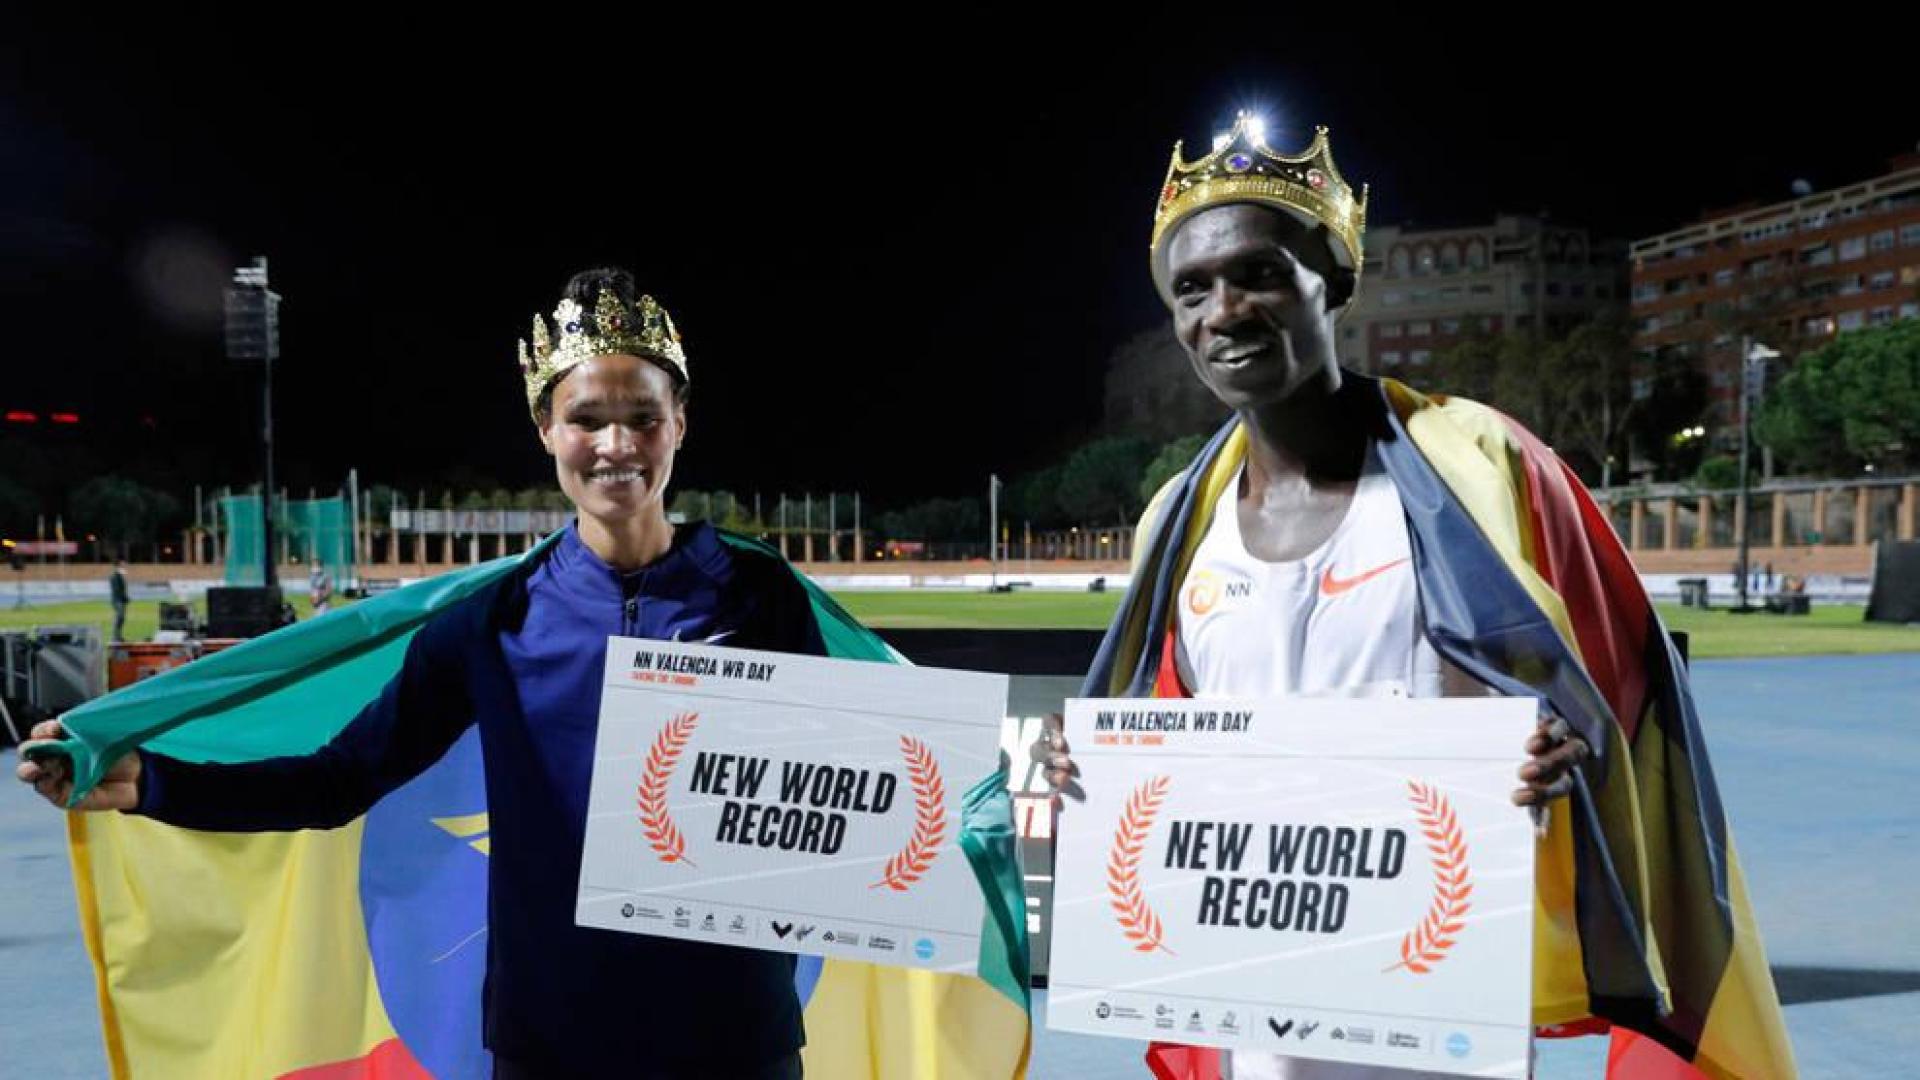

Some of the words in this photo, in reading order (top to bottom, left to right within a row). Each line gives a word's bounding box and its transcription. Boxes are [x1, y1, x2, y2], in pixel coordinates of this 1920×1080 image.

[1226, 583, 1252, 597] NN
[633, 650, 654, 669] NN
[657, 652, 718, 675] VALENCIA
[722, 659, 745, 679] WR
[747, 662, 777, 682] DAY
[1095, 711, 1117, 731] NN
[1120, 711, 1187, 731] VALENCIA
[1193, 711, 1218, 731] WR
[1221, 711, 1253, 732] DAY
[689, 752, 770, 800] NEW
[780, 760, 897, 815] WORLD
[716, 800, 847, 856] RECORD
[1164, 821, 1254, 872] NEW
[1267, 823, 1407, 879] WORLD
[1197, 876, 1350, 934] RECORD
